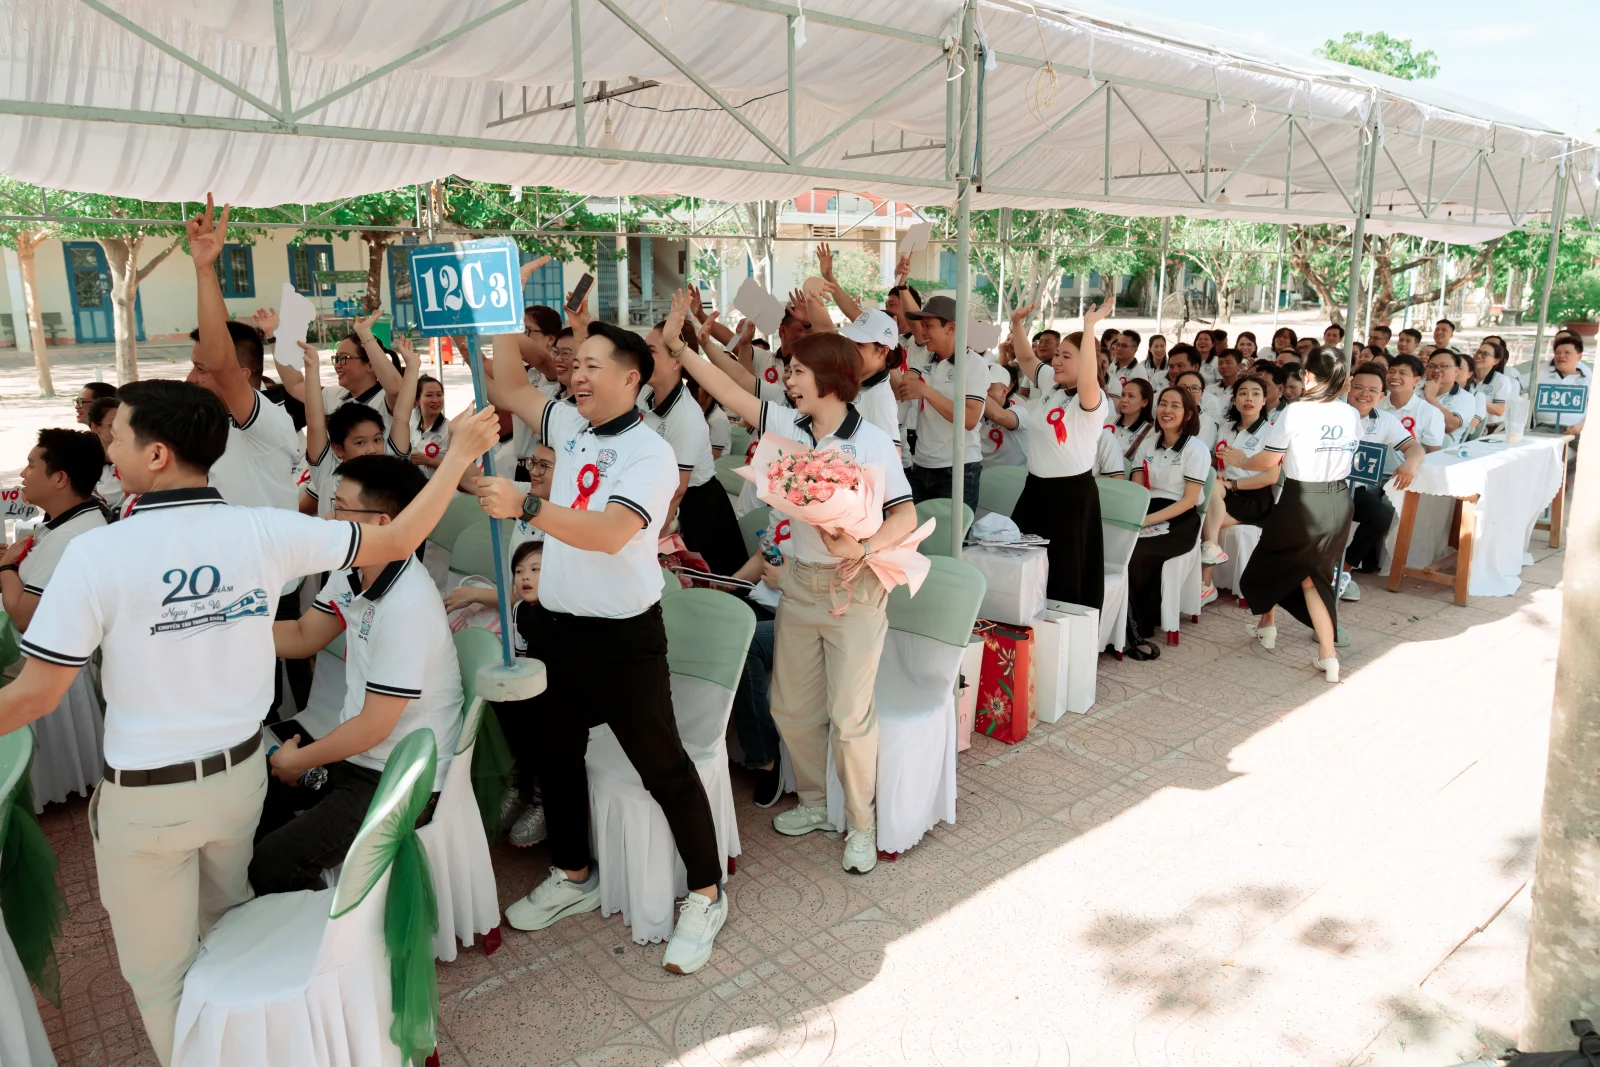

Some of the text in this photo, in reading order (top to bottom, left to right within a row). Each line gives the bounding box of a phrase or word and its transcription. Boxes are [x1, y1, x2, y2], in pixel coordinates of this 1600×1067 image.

[420, 261, 508, 312] 12C3
[1540, 391, 1581, 406] 12C6
[1320, 425, 1343, 440] 20
[1353, 451, 1378, 474] C7
[162, 565, 221, 607] 20
